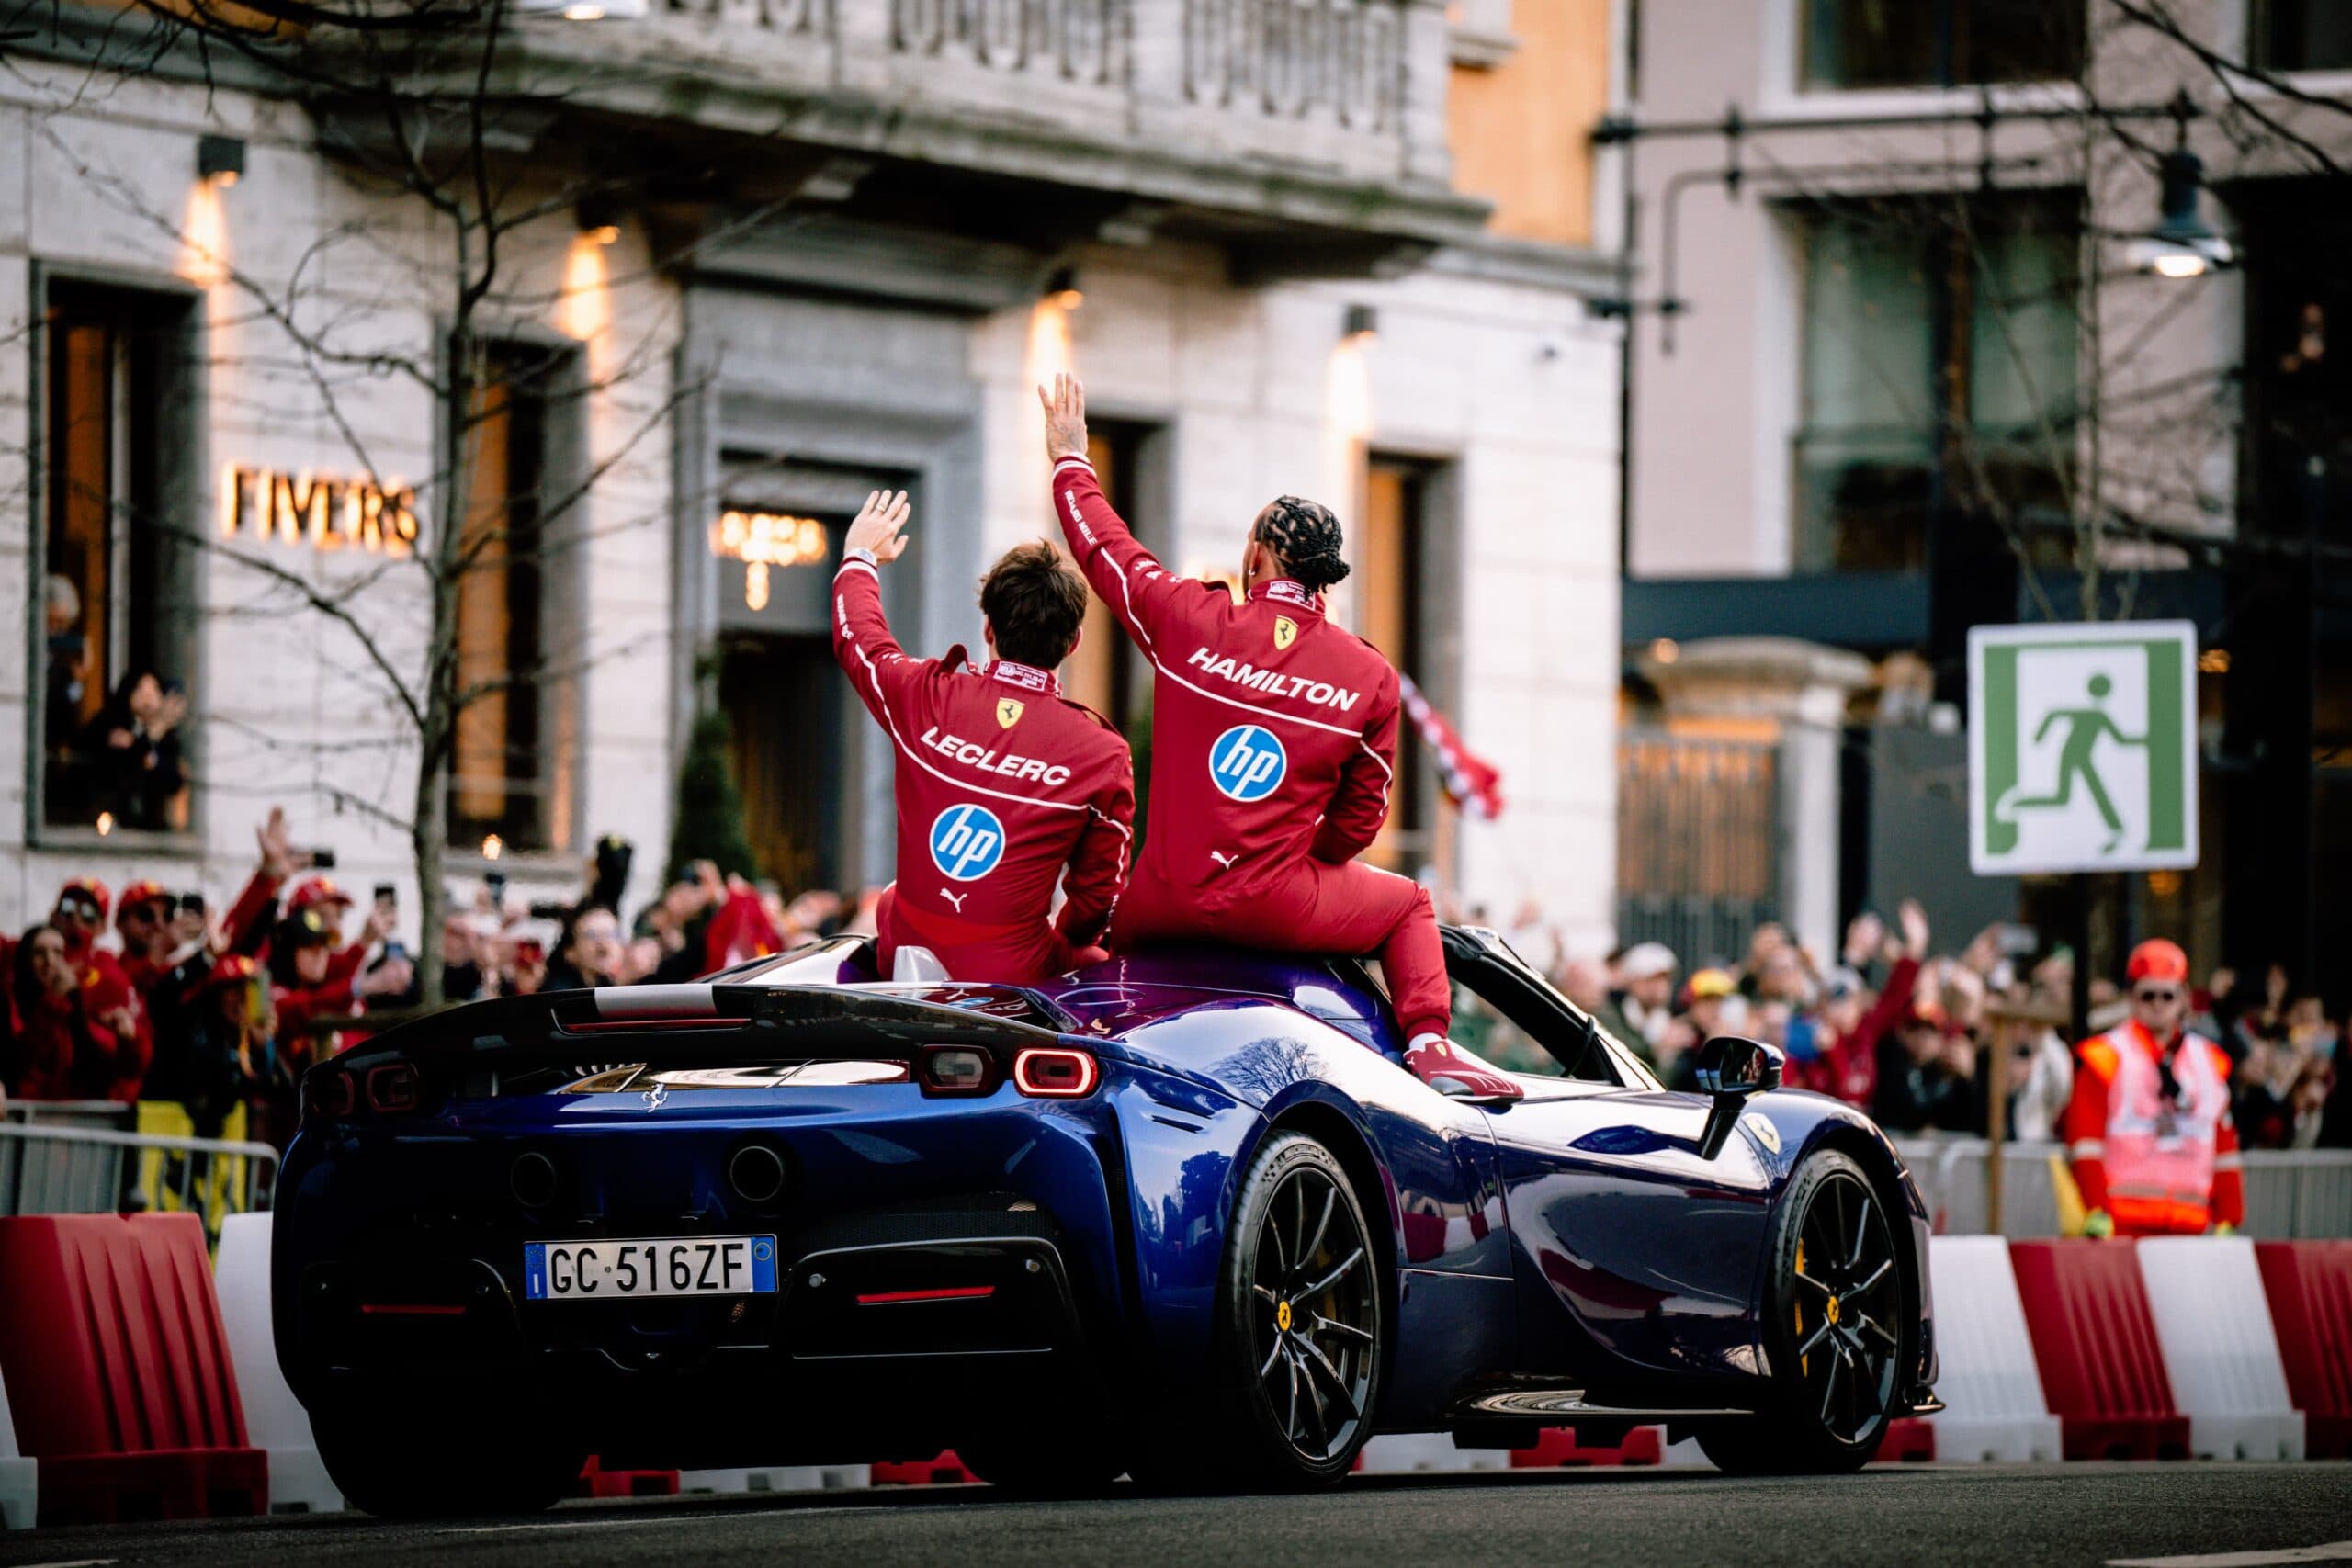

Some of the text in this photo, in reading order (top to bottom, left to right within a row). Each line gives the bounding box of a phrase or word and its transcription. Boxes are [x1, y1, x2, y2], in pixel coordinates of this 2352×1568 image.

[221, 462, 419, 558] FIVERS
[1187, 647, 1360, 711] HAMILTON
[920, 726, 1071, 785] LECLERC
[1216, 727, 1280, 797] hp
[935, 806, 999, 878] hp
[550, 1242, 744, 1293] GC 516ZF
